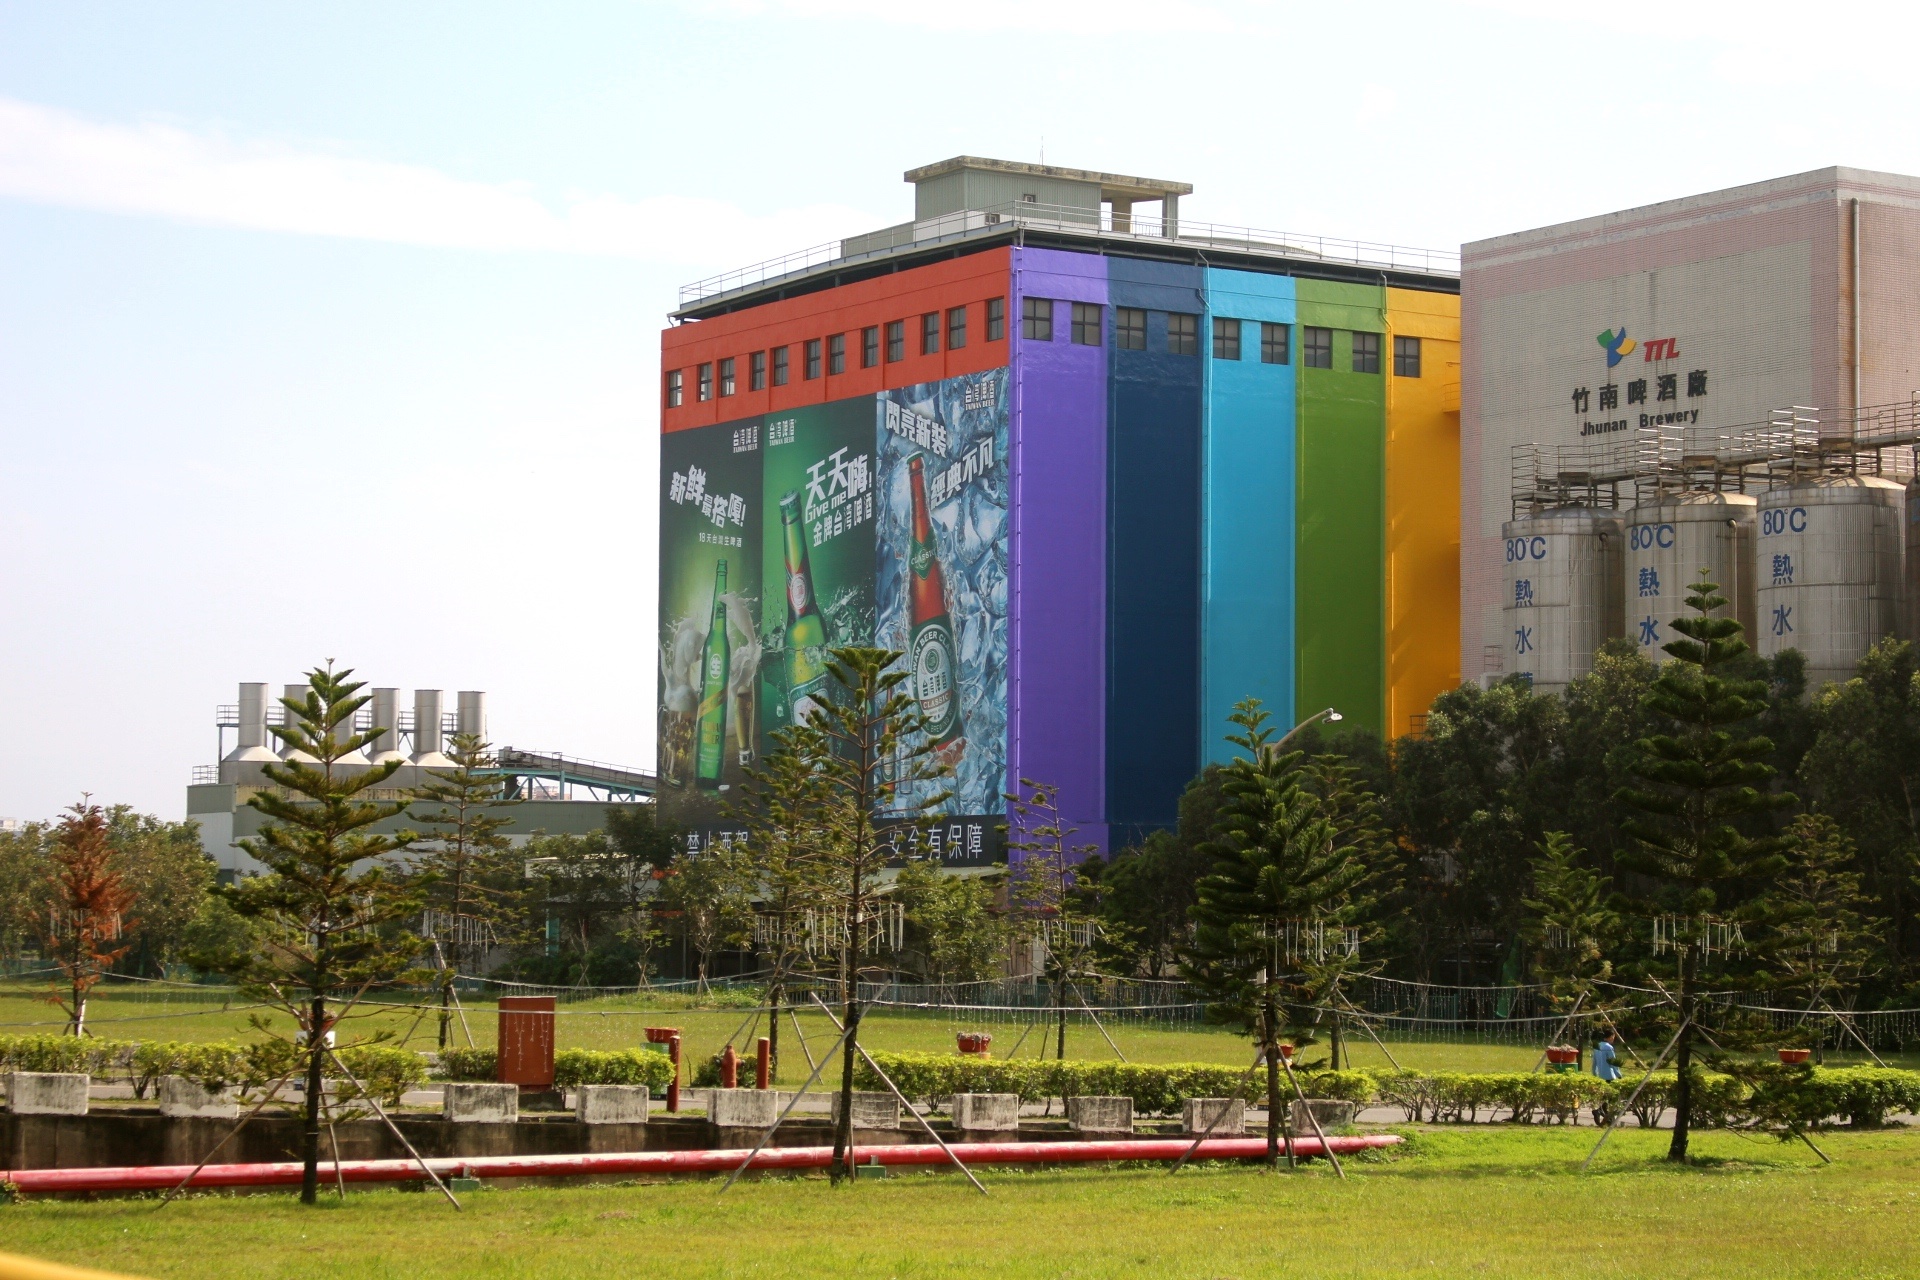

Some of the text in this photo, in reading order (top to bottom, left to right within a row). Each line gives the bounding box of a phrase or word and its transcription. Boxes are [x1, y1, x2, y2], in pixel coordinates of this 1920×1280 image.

[1643, 338, 1680, 362] TTL
[965, 399, 995, 410] TAIWAN BEER
[1572, 369, 1707, 414] 竹南啤酒廠
[886, 399, 947, 458] 閃亮新裝
[1580, 409, 1699, 436] Jhunan Brewery
[931, 436, 994, 510] 經典不凡
[805, 491, 847, 524] Give me
[1639, 567, 1660, 645] 熱水
[1772, 554, 1793, 636] 熱水
[919, 631, 938, 647] BEER
[1515, 579, 1534, 688] 熱水
[923, 692, 949, 709] CLASSIC
[889, 823, 982, 859] 安全有保障
